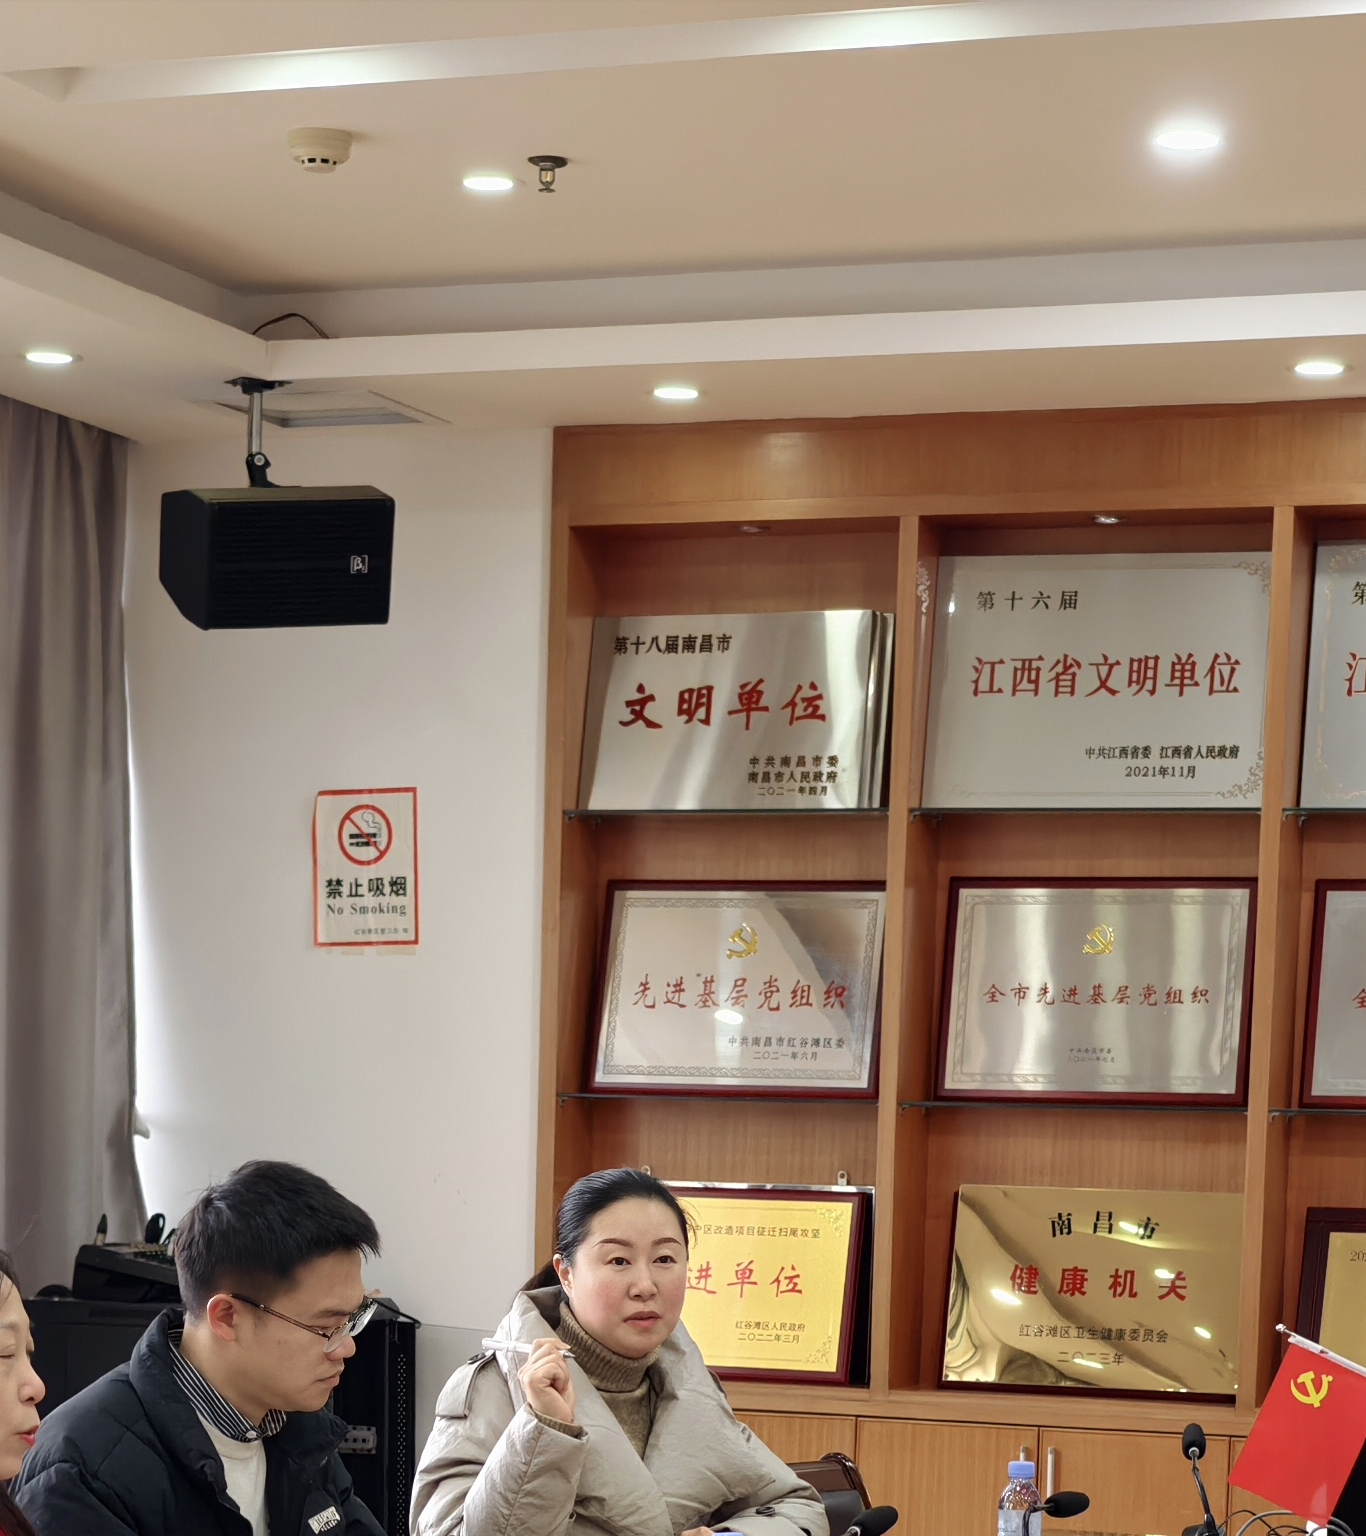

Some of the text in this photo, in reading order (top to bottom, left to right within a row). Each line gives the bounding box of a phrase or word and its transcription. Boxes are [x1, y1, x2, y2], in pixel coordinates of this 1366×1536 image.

[976, 590, 1079, 612] 第十六届
[613, 633, 733, 656] 第十八届南昌市
[970, 651, 1242, 698] 江西省文明单位
[618, 678, 827, 731] 文明单位
[1084, 745, 1241, 760] 中共江西省委 江西省人民政府
[747, 770, 838, 785] 南昌市人民政府
[1124, 765, 1197, 780] 2021年11月
[325, 876, 408, 900] 禁止吸烟
[326, 902, 408, 917] No Smoking
[631, 973, 848, 1012] 先进基层党组织
[983, 981, 1211, 1007] 全市先进基层党组织
[1047, 1210, 1161, 1241] 南昌市
[1009, 1264, 1188, 1301] 健康机关
